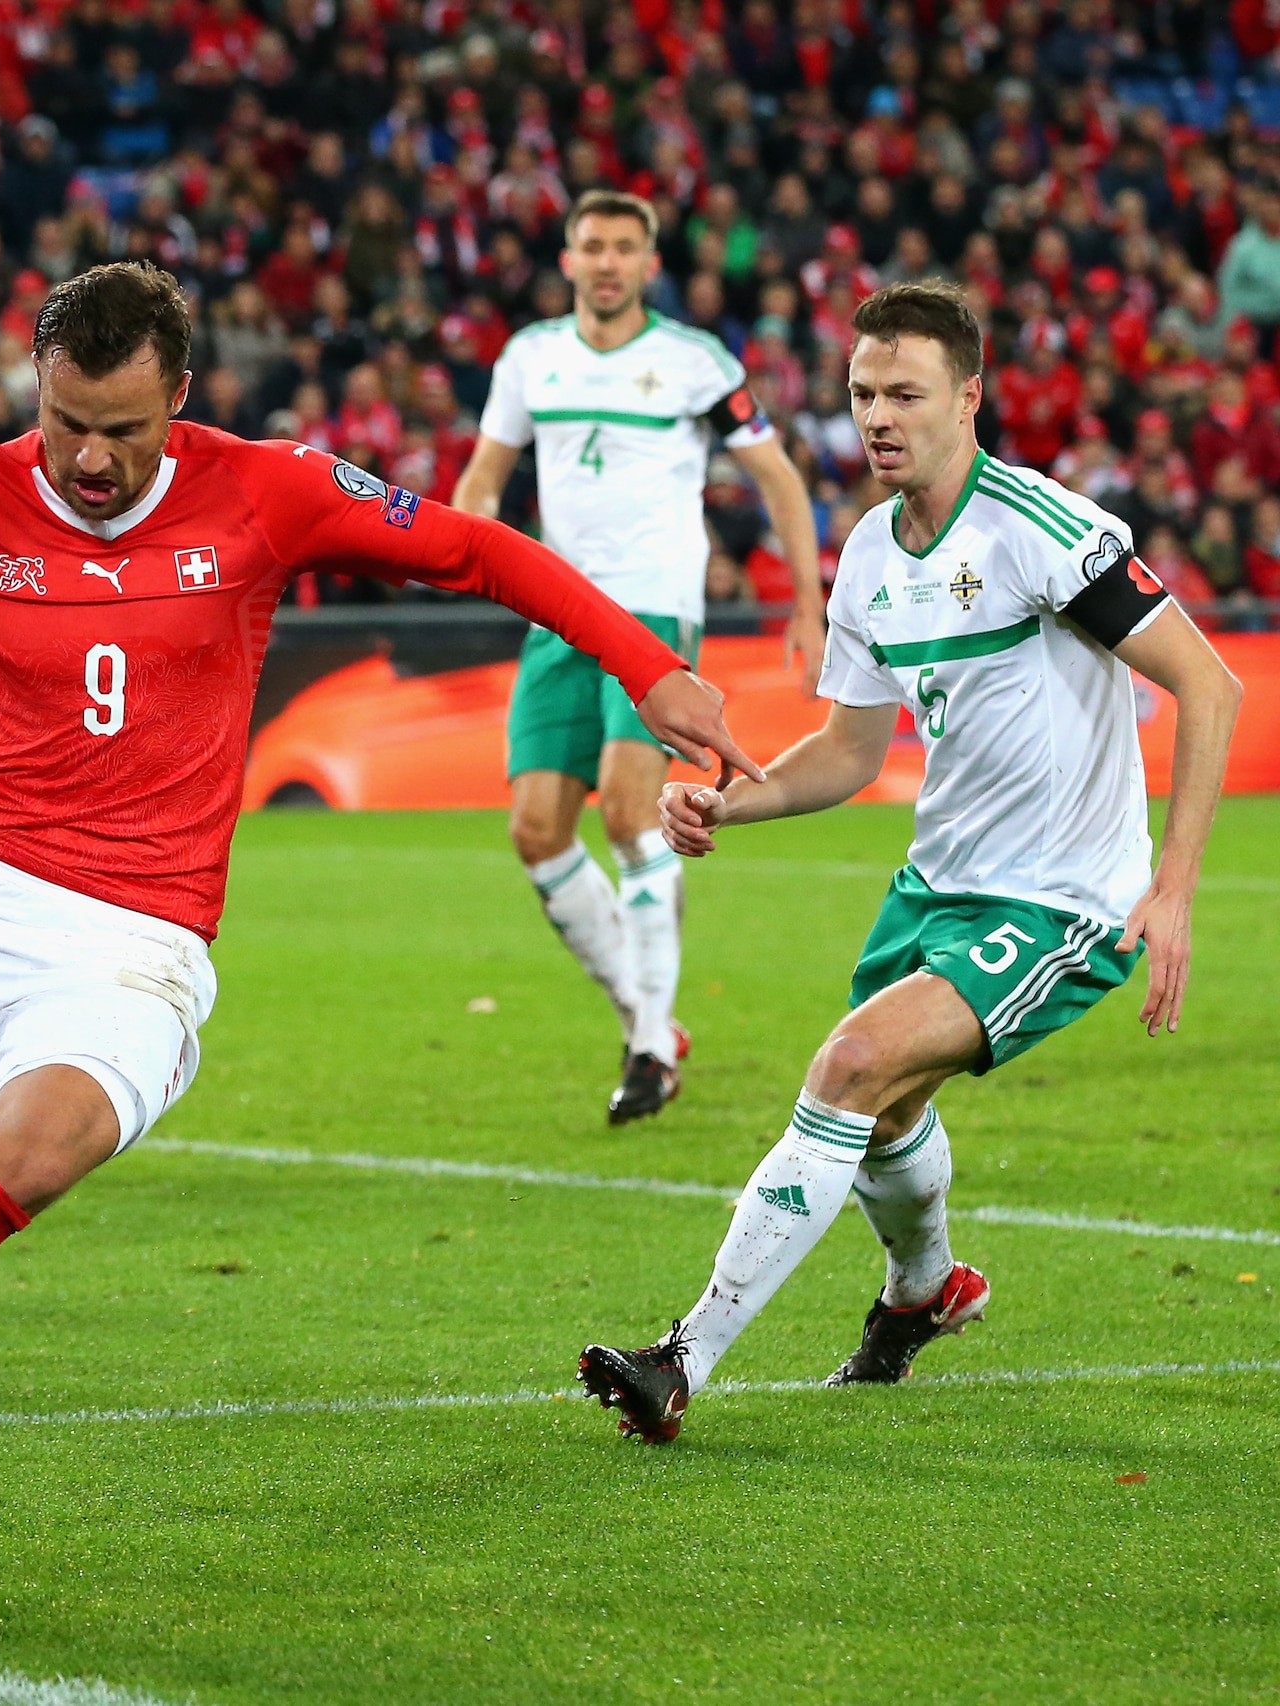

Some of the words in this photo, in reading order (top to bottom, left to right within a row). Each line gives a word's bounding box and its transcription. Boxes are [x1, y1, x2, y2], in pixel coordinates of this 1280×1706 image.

[579, 426, 604, 475] 4
[83, 642, 126, 737] 9
[917, 666, 948, 739] 5
[968, 921, 1037, 975] 5
[757, 1186, 811, 1217] adidas
